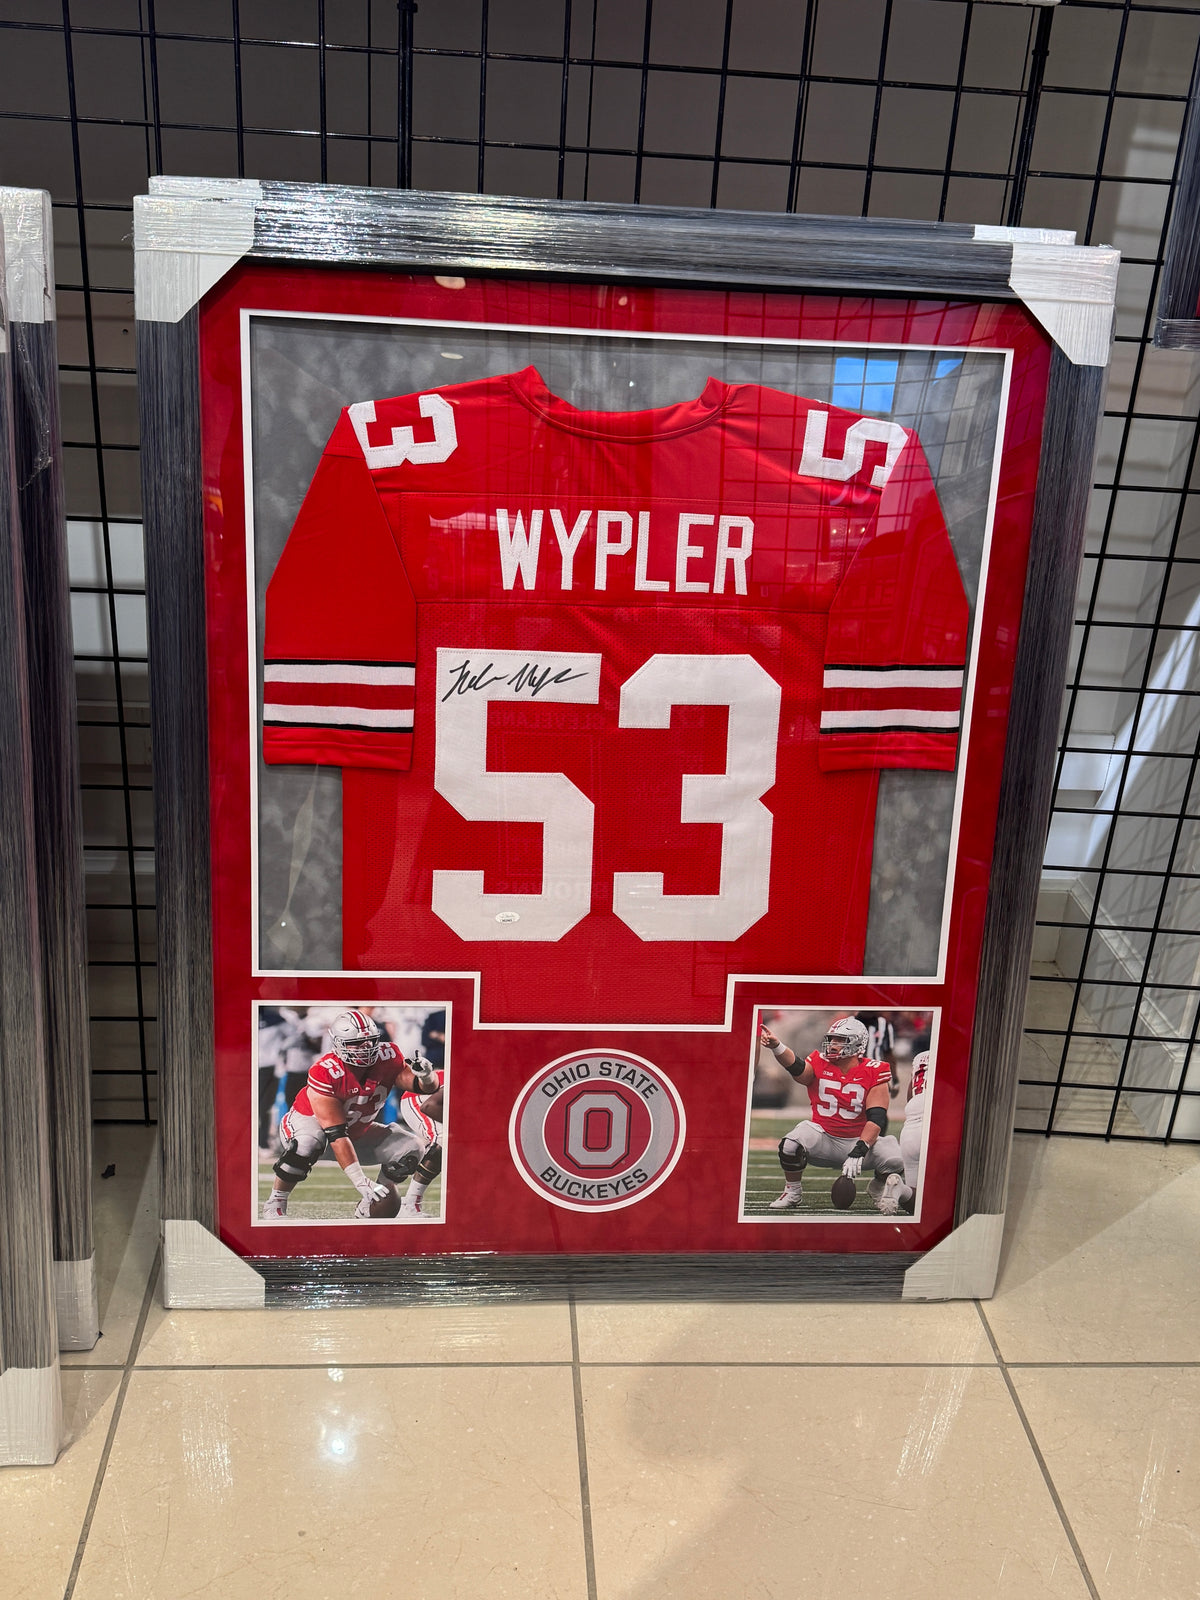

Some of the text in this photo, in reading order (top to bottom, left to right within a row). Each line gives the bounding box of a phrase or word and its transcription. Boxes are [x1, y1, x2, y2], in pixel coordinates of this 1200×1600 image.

[496, 508, 755, 596] WYPLER
[431, 647, 783, 943] 53
[320, 1058, 345, 1080] 53
[541, 1061, 659, 1100] OHIO STATE
[817, 1079, 865, 1120] 53
[563, 1090, 633, 1170] O
[539, 1166, 649, 1199] BUCKEYES
